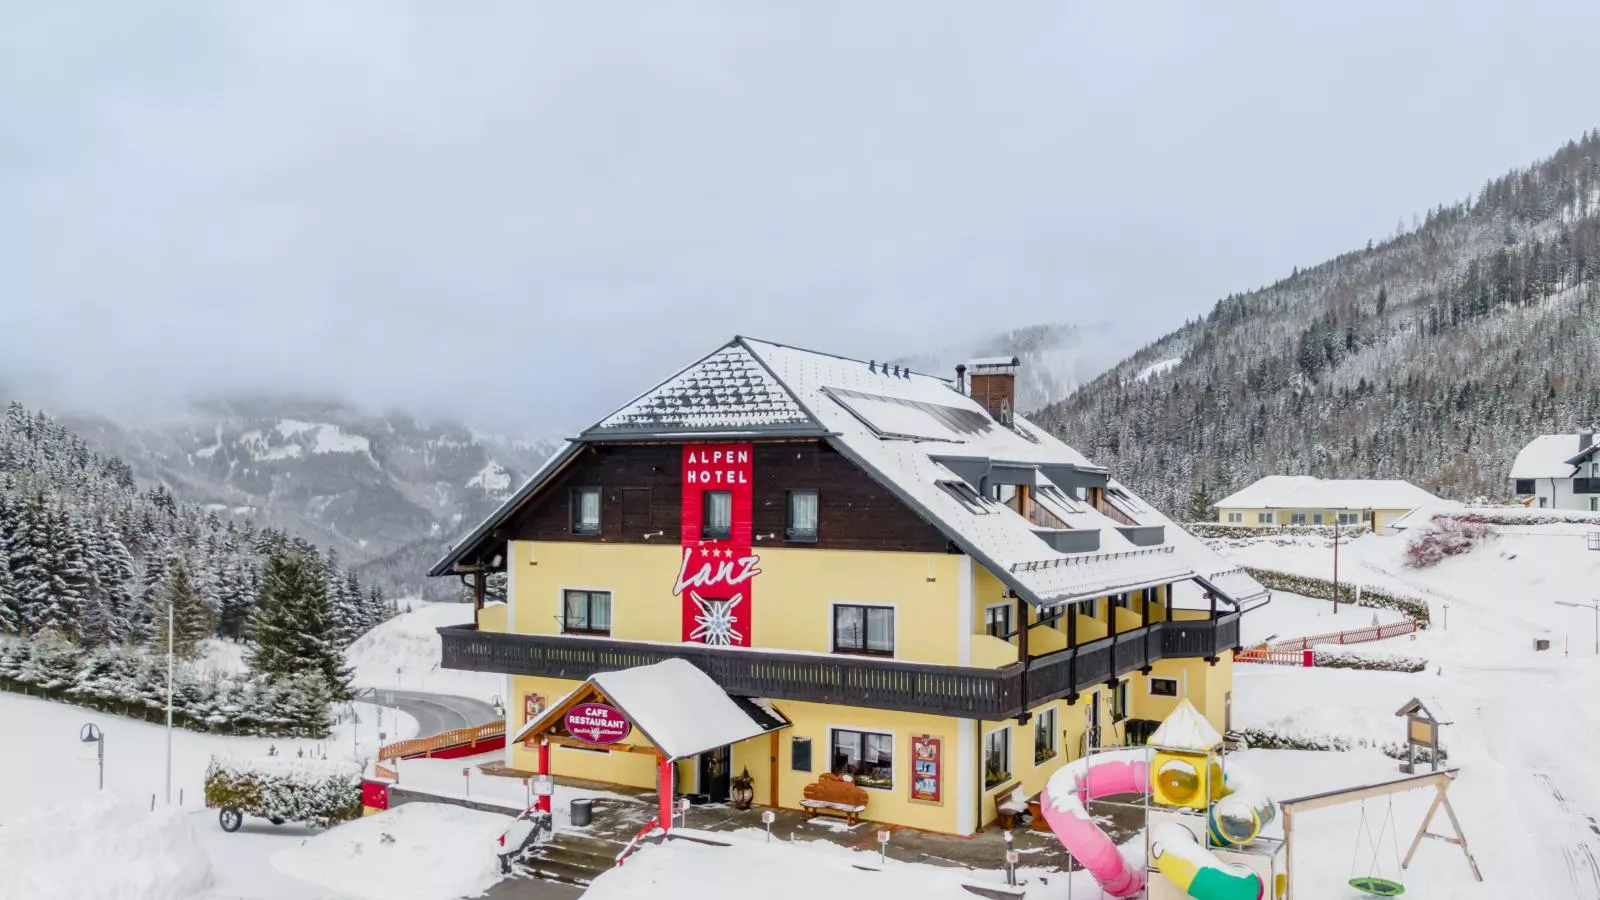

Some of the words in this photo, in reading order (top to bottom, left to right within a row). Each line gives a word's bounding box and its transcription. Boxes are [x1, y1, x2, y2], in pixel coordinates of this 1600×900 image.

[688, 451, 748, 464] ALPEN
[687, 470, 747, 483] HOTEL
[673, 547, 762, 597] Lanz
[585, 708, 608, 718] CAFE
[569, 716, 625, 728] RESTAURANT
